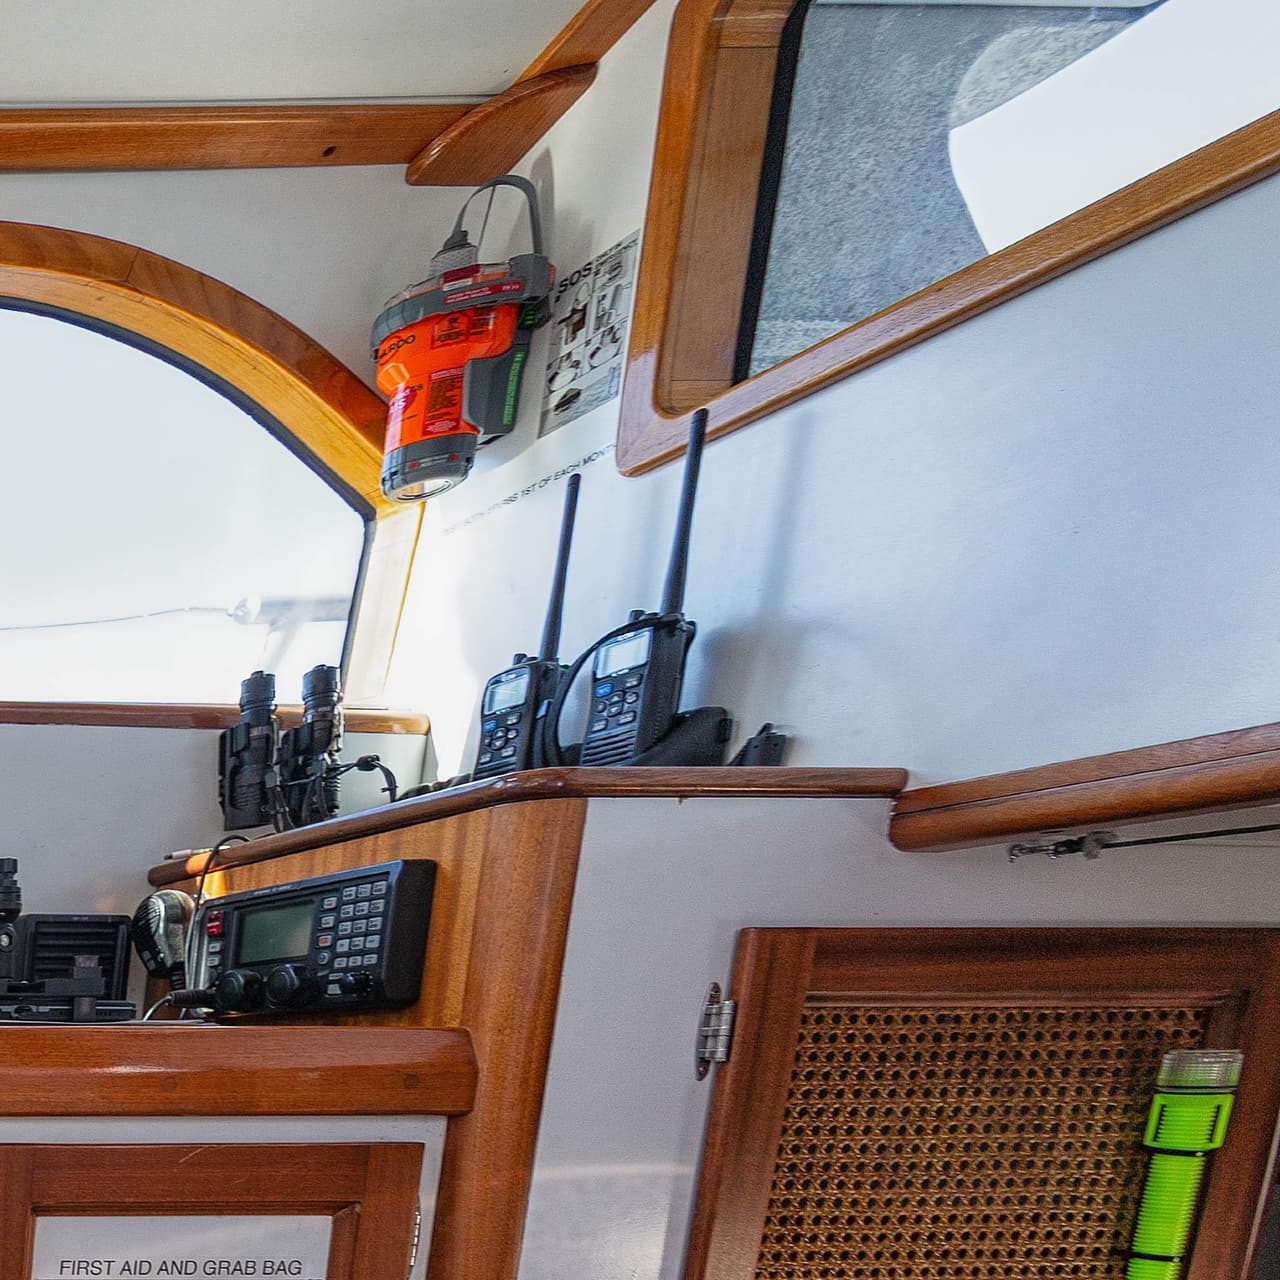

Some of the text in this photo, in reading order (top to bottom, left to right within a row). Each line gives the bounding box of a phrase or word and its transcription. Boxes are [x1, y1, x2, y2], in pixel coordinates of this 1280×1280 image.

[554, 461, 580, 481] EACH
[60, 1260, 303, 1275] FIRST AID AND GRAB BAG
